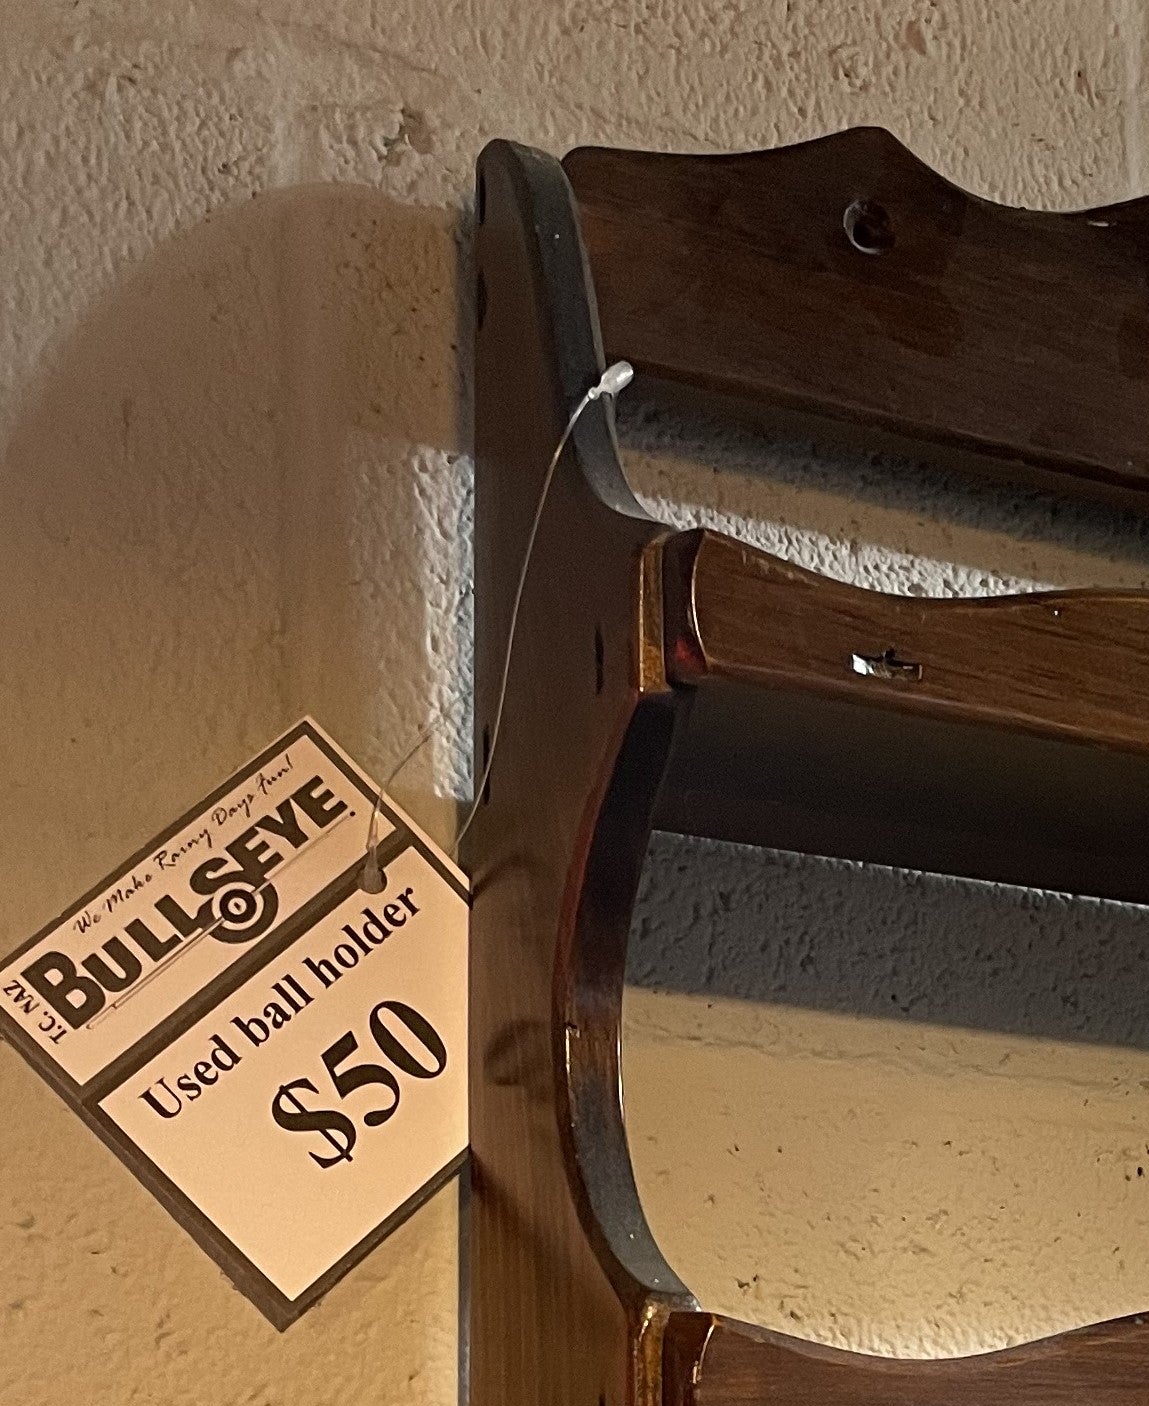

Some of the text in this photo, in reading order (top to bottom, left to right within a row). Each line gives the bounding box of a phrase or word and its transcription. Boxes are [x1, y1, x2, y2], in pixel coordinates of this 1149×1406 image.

[20, 775, 349, 1030] BULLSEYE
[73, 753, 294, 934] We Make Rainy Days Fun!
[138, 886, 421, 1119] Used ball holder
[271, 1000, 448, 1169] $50
